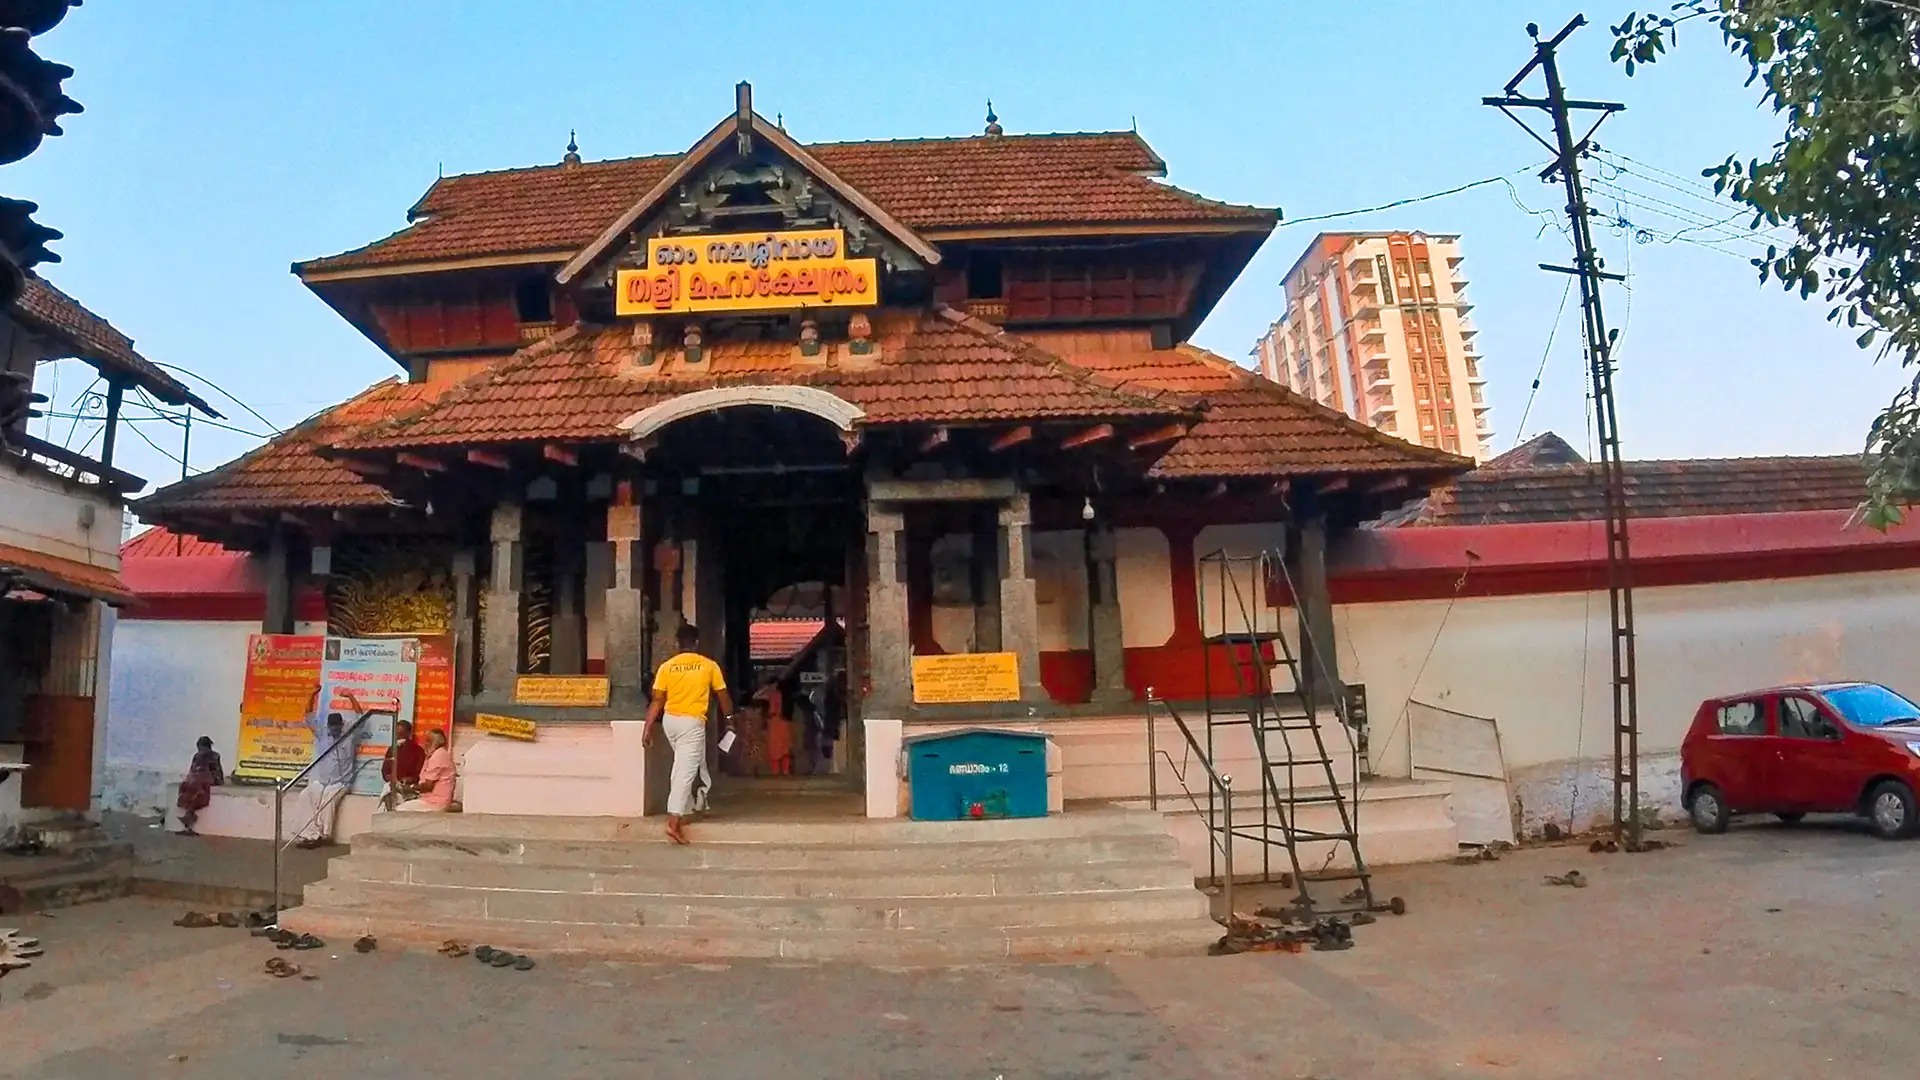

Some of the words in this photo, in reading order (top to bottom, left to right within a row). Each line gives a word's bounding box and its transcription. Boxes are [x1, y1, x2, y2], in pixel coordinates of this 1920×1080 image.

[656, 244, 697, 265] ഓം
[626, 266, 681, 309] തളി
[689, 267, 868, 302] മഹാക്ഷേത്രം
[998, 763, 1009, 773] 12
